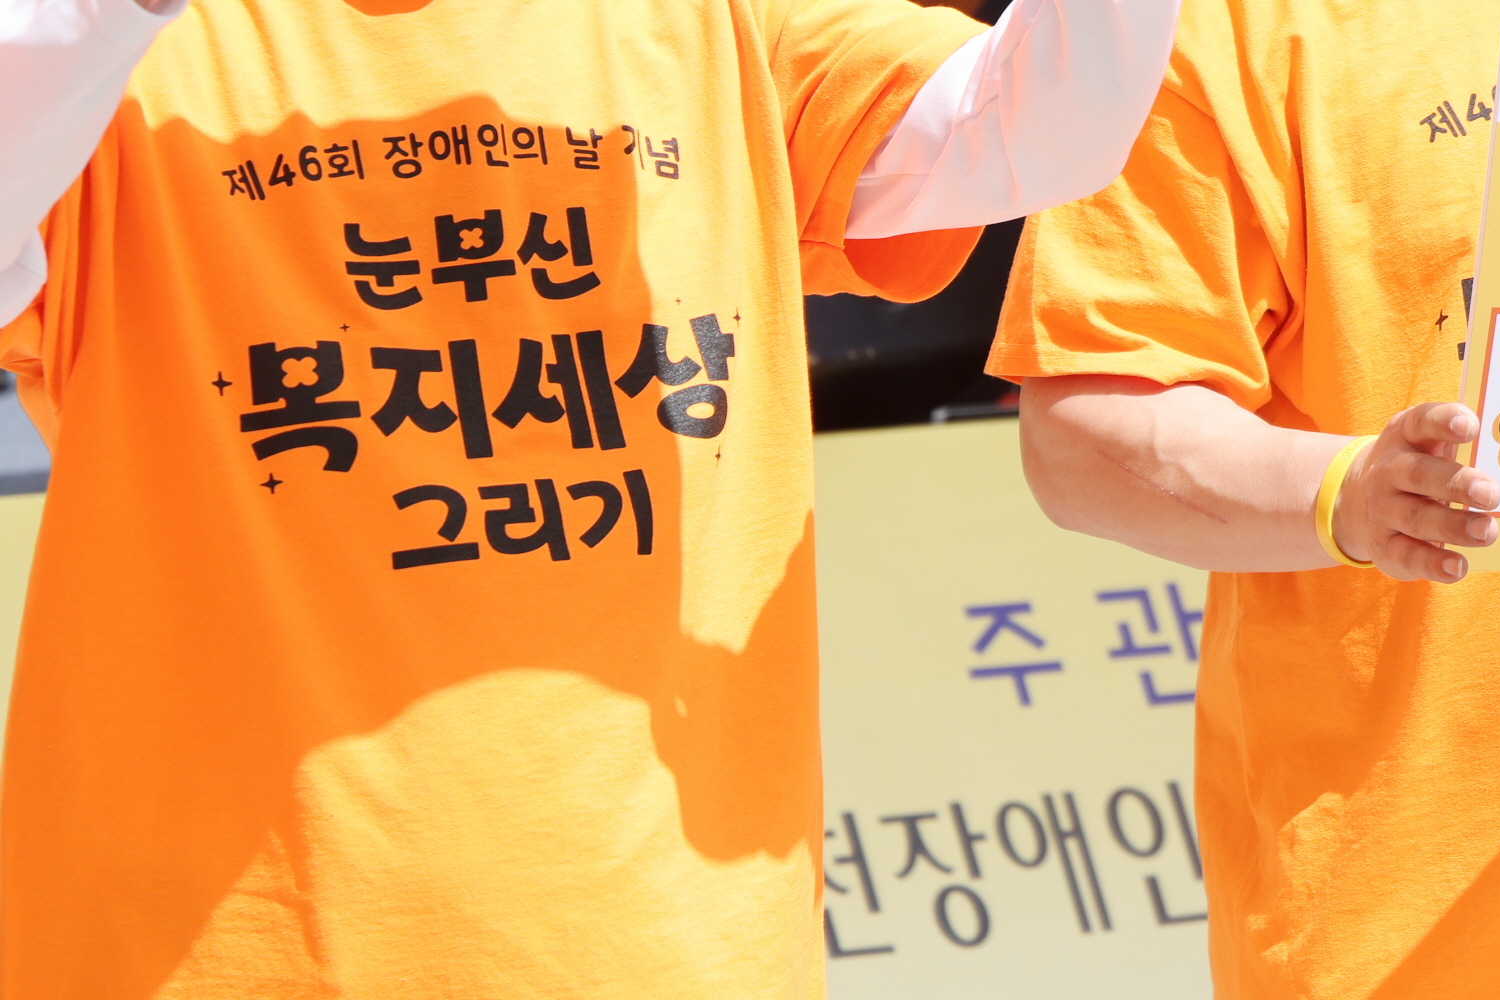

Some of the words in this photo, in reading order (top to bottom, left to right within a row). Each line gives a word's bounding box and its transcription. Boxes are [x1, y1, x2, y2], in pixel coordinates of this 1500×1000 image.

[221, 138, 366, 201] 제46회
[382, 122, 549, 180] 장애인의
[564, 126, 603, 171] 날
[620, 123, 681, 180] 기념
[1419, 84, 1497, 144] 제4
[342, 206, 602, 311] 눈부신
[239, 313, 736, 474] 복지세상
[391, 468, 654, 571] 그리기
